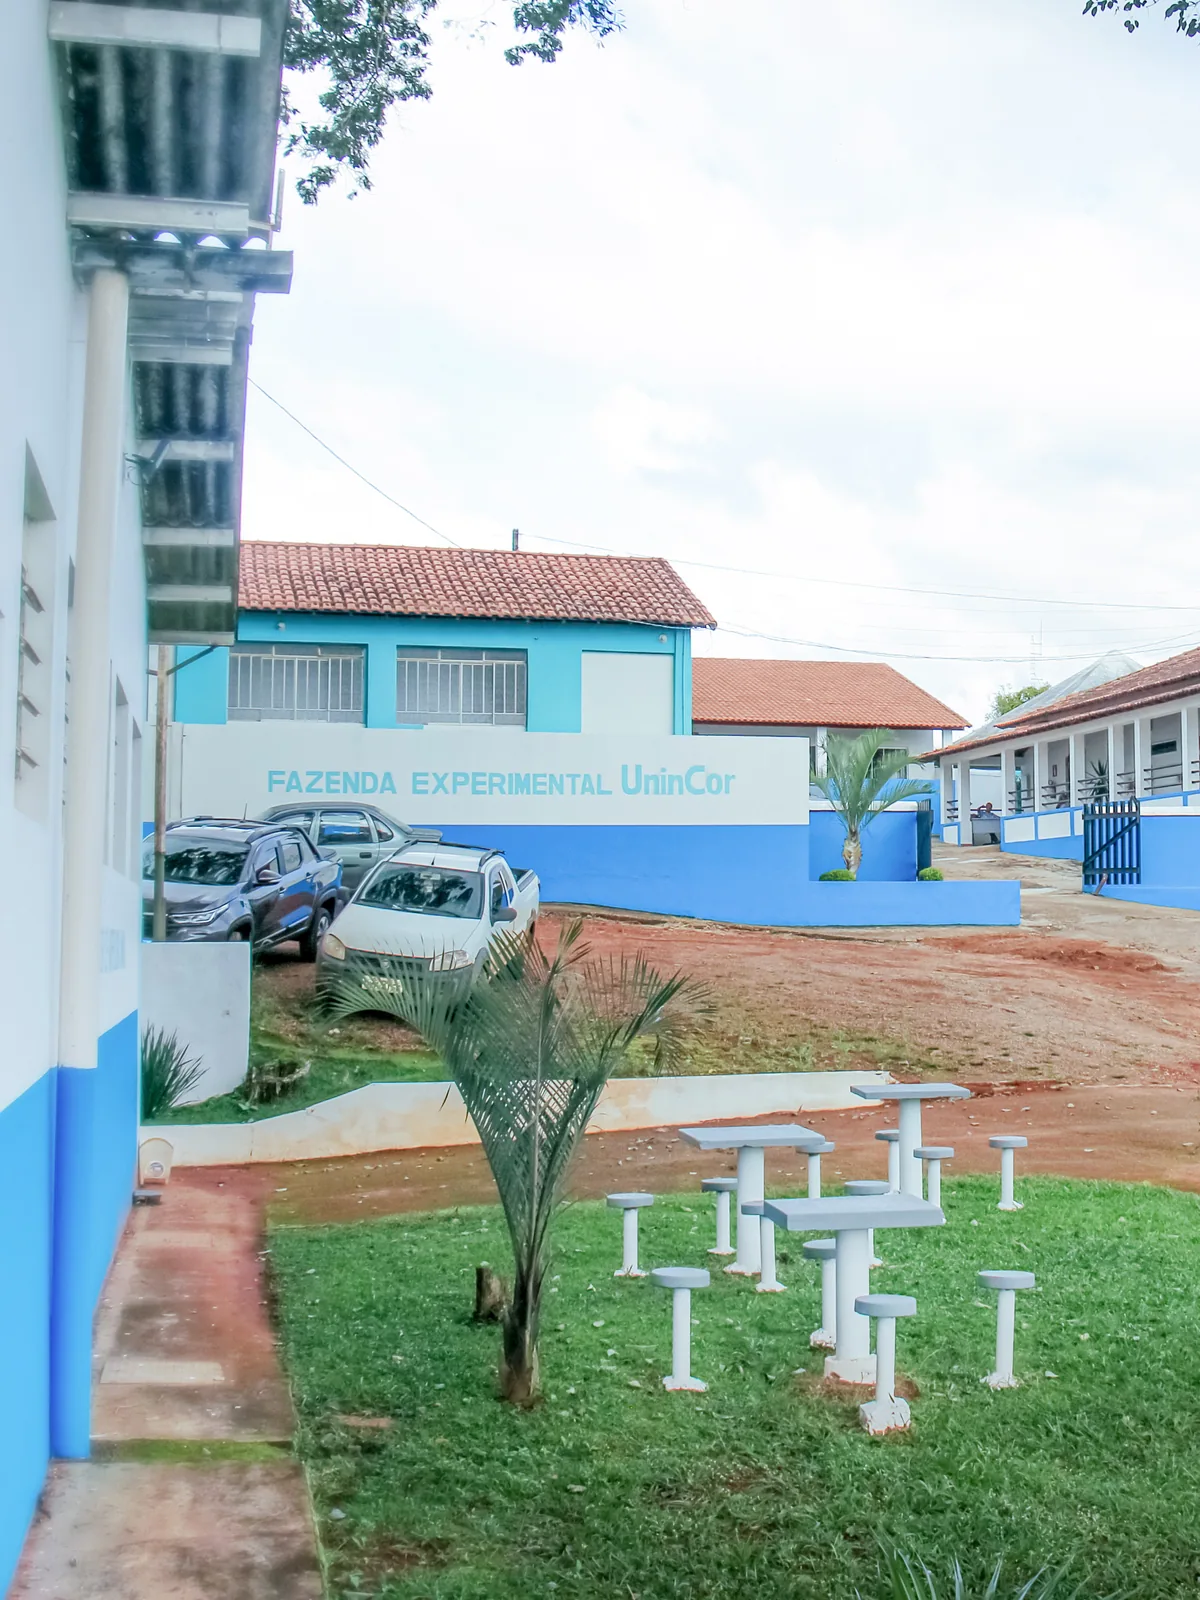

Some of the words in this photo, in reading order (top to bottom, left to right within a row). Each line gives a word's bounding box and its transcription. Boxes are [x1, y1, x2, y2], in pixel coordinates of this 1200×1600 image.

[267, 770, 397, 794] FAZENDA
[411, 771, 613, 795] EXPERIMENTAL
[621, 764, 735, 795] UninCor
